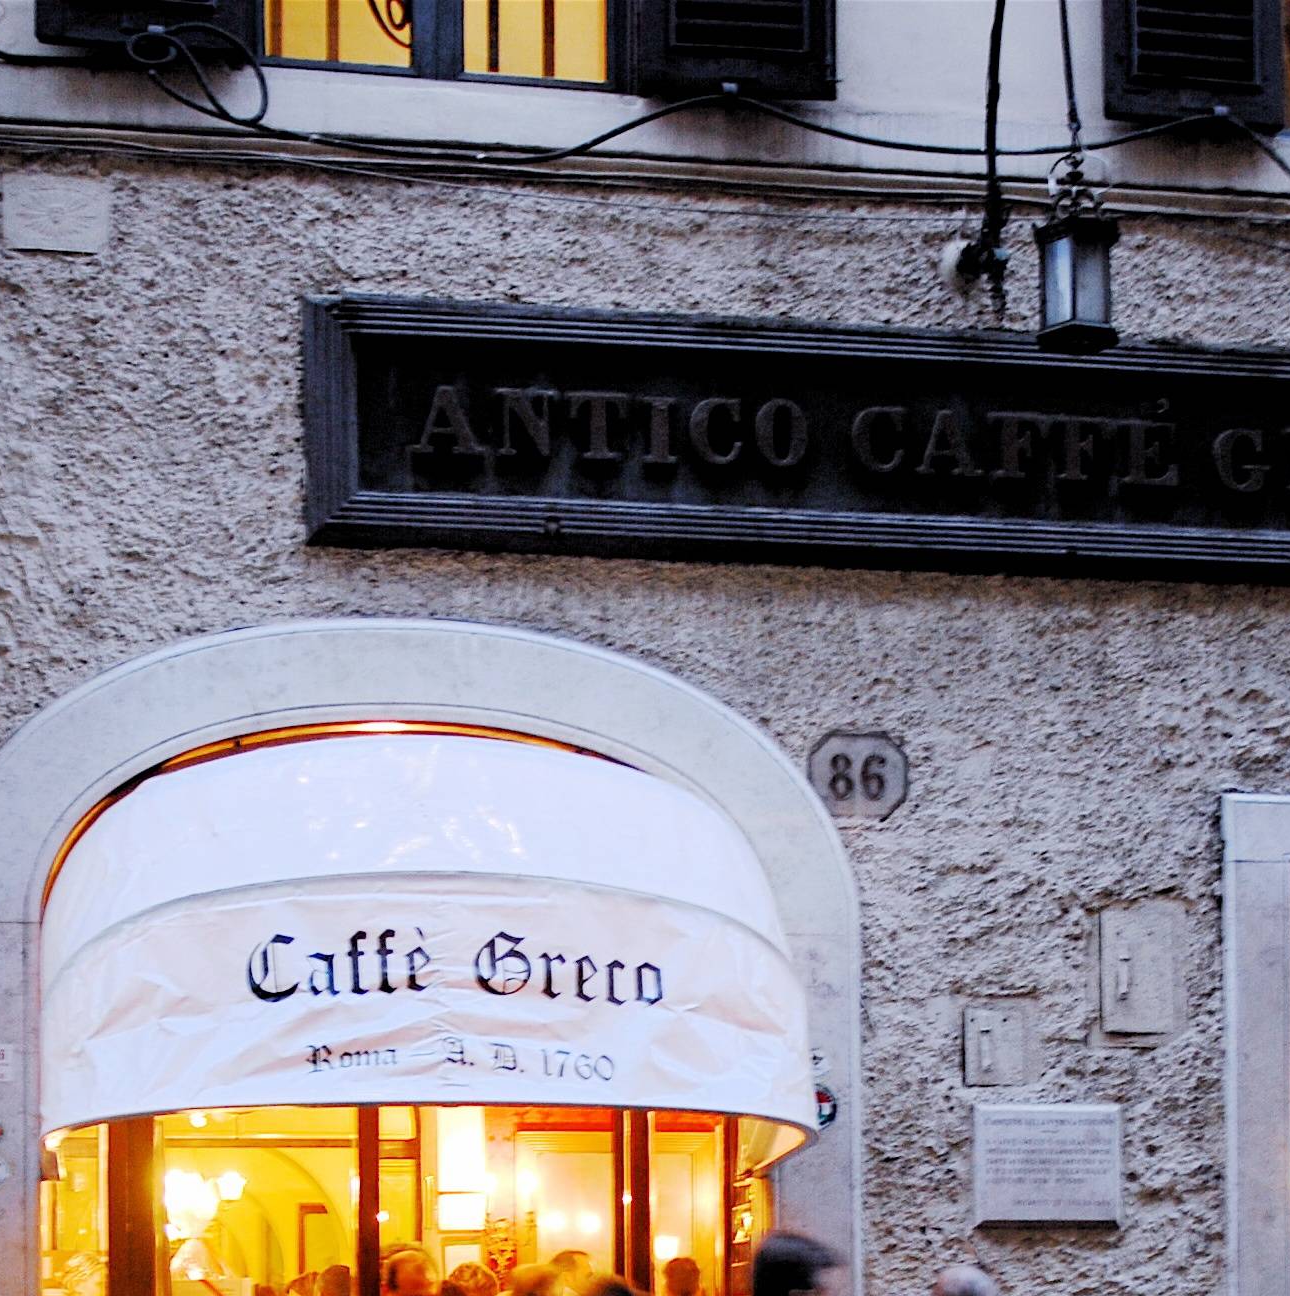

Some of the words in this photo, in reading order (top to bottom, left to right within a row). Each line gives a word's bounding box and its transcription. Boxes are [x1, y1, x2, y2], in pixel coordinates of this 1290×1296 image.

[412, 386, 807, 467] ANTICO
[828, 753, 886, 801] 86
[246, 927, 433, 1003] Caffè
[474, 931, 665, 1006] Greco
[306, 1045, 398, 1073] Roma
[541, 1049, 614, 1081] 1760
